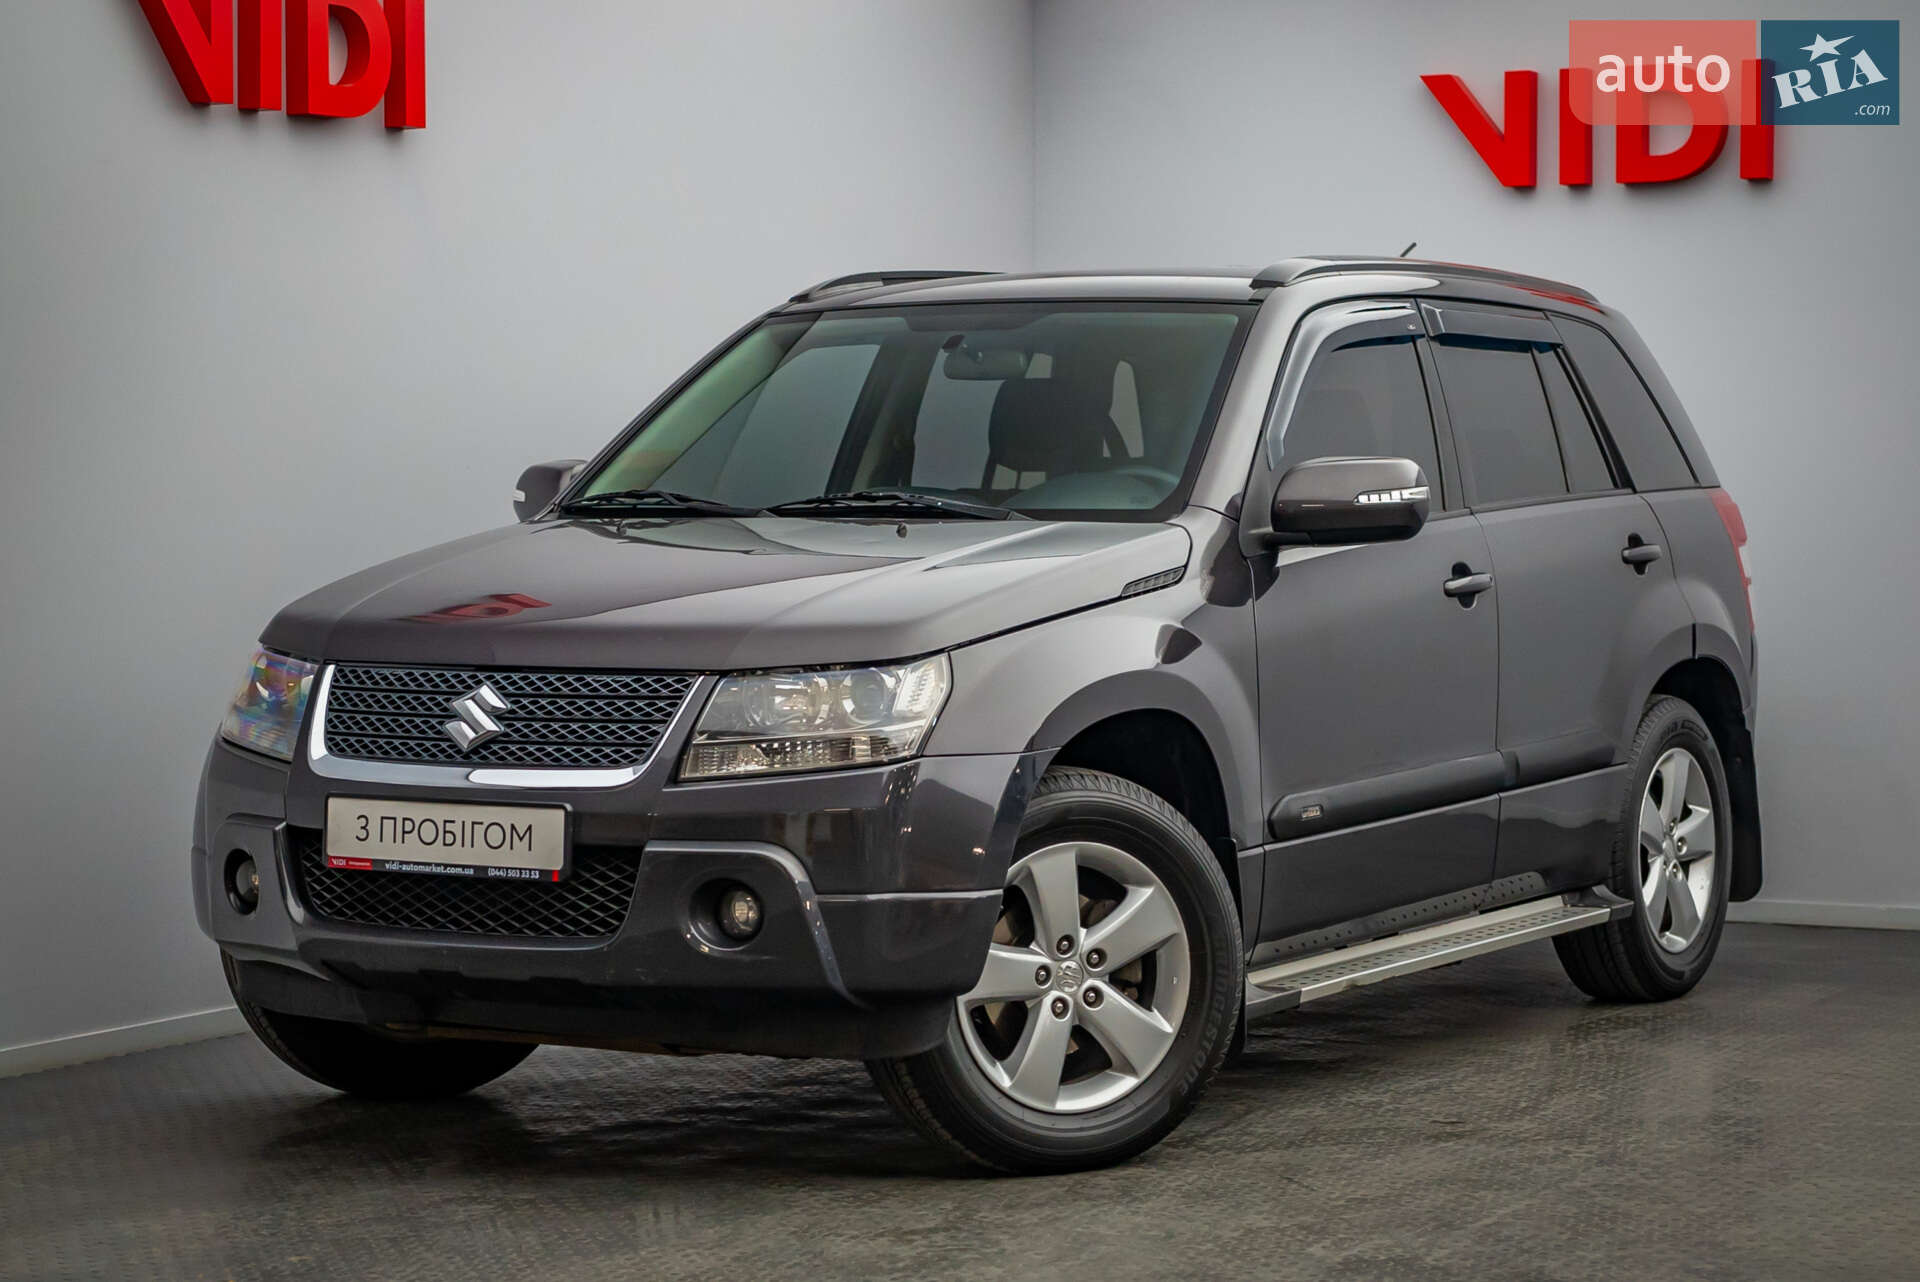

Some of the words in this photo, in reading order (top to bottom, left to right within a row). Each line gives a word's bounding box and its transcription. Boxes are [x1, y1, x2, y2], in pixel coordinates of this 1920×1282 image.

[137, 0, 427, 129] VIDI
[1420, 59, 1775, 188] VIDI
[379, 815, 533, 851] ПРОБІГОМ
[331, 858, 347, 866] VIDI
[385, 861, 474, 875] vidi-automarket.com.ua
[507, 869, 520, 878] 503
[530, 870, 540, 879] 53
